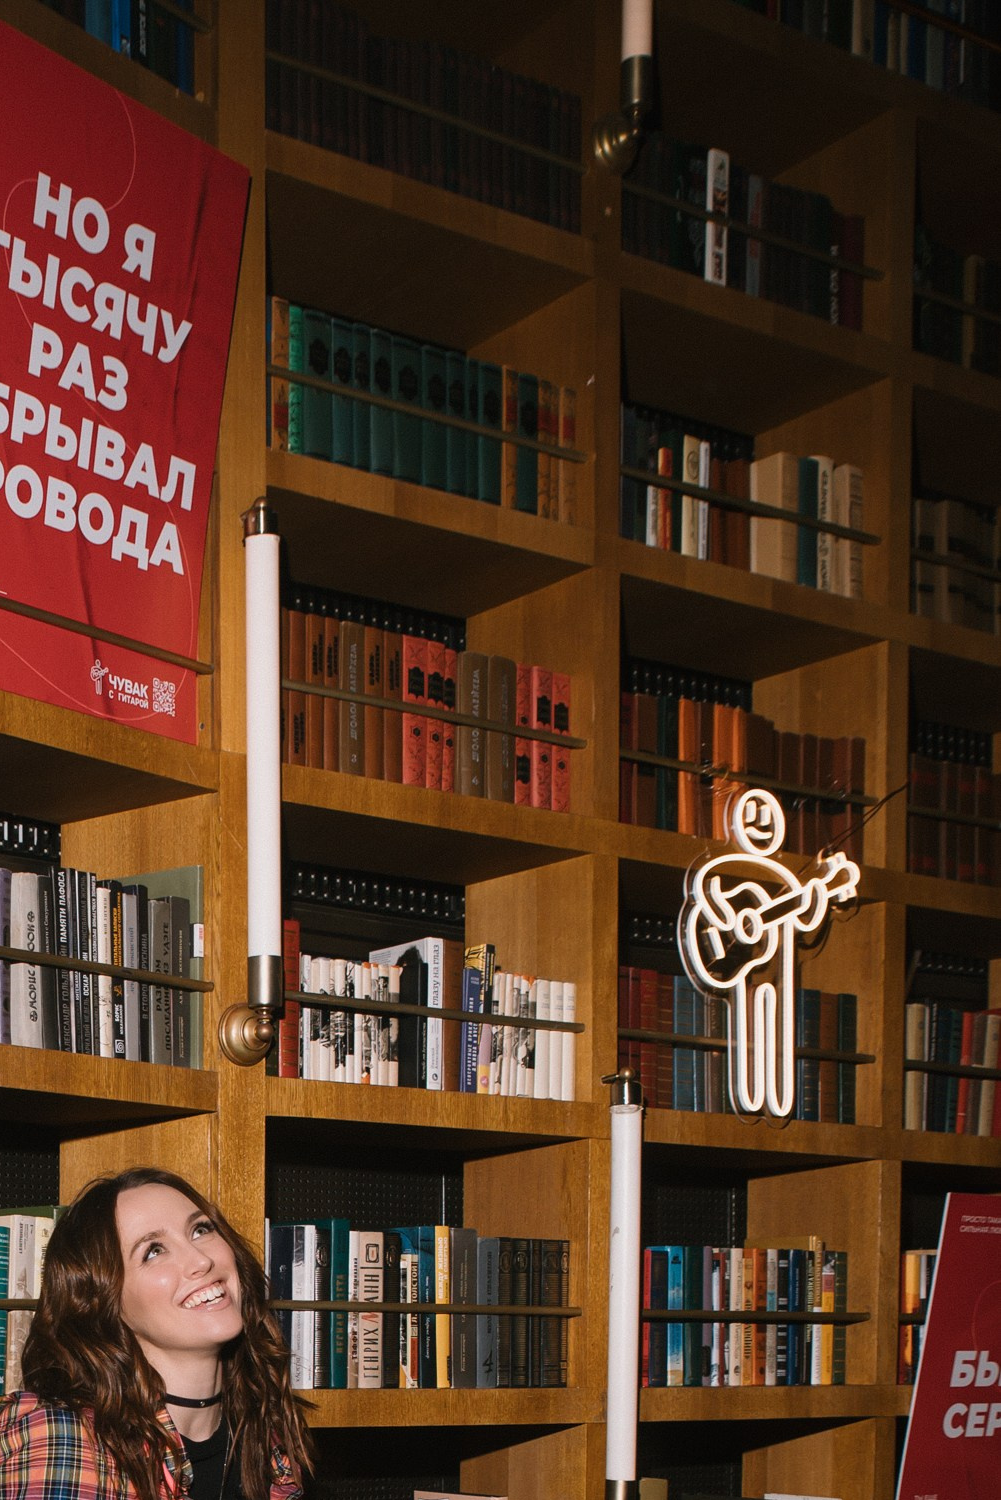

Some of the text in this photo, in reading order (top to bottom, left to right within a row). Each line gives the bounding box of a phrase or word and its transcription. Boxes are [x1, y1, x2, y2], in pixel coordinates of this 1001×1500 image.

[31, 171, 158, 283] НО Я
[28, 322, 130, 413] РАЗ
[108, 671, 150, 700] ЧУВАК
[108, 689, 150, 710] С ГИТАРОЙ
[56, 871, 72, 1052] АЛЕКСАНДР ПАМЯТИ ПАФОСА
[161, 922, 171, 956] УДЭГЕ
[81, 974, 90, 997] ОСКАР
[430, 944, 441, 1006] глазу на глаз
[363, 1328, 379, 1379] ГЕНРИХ
